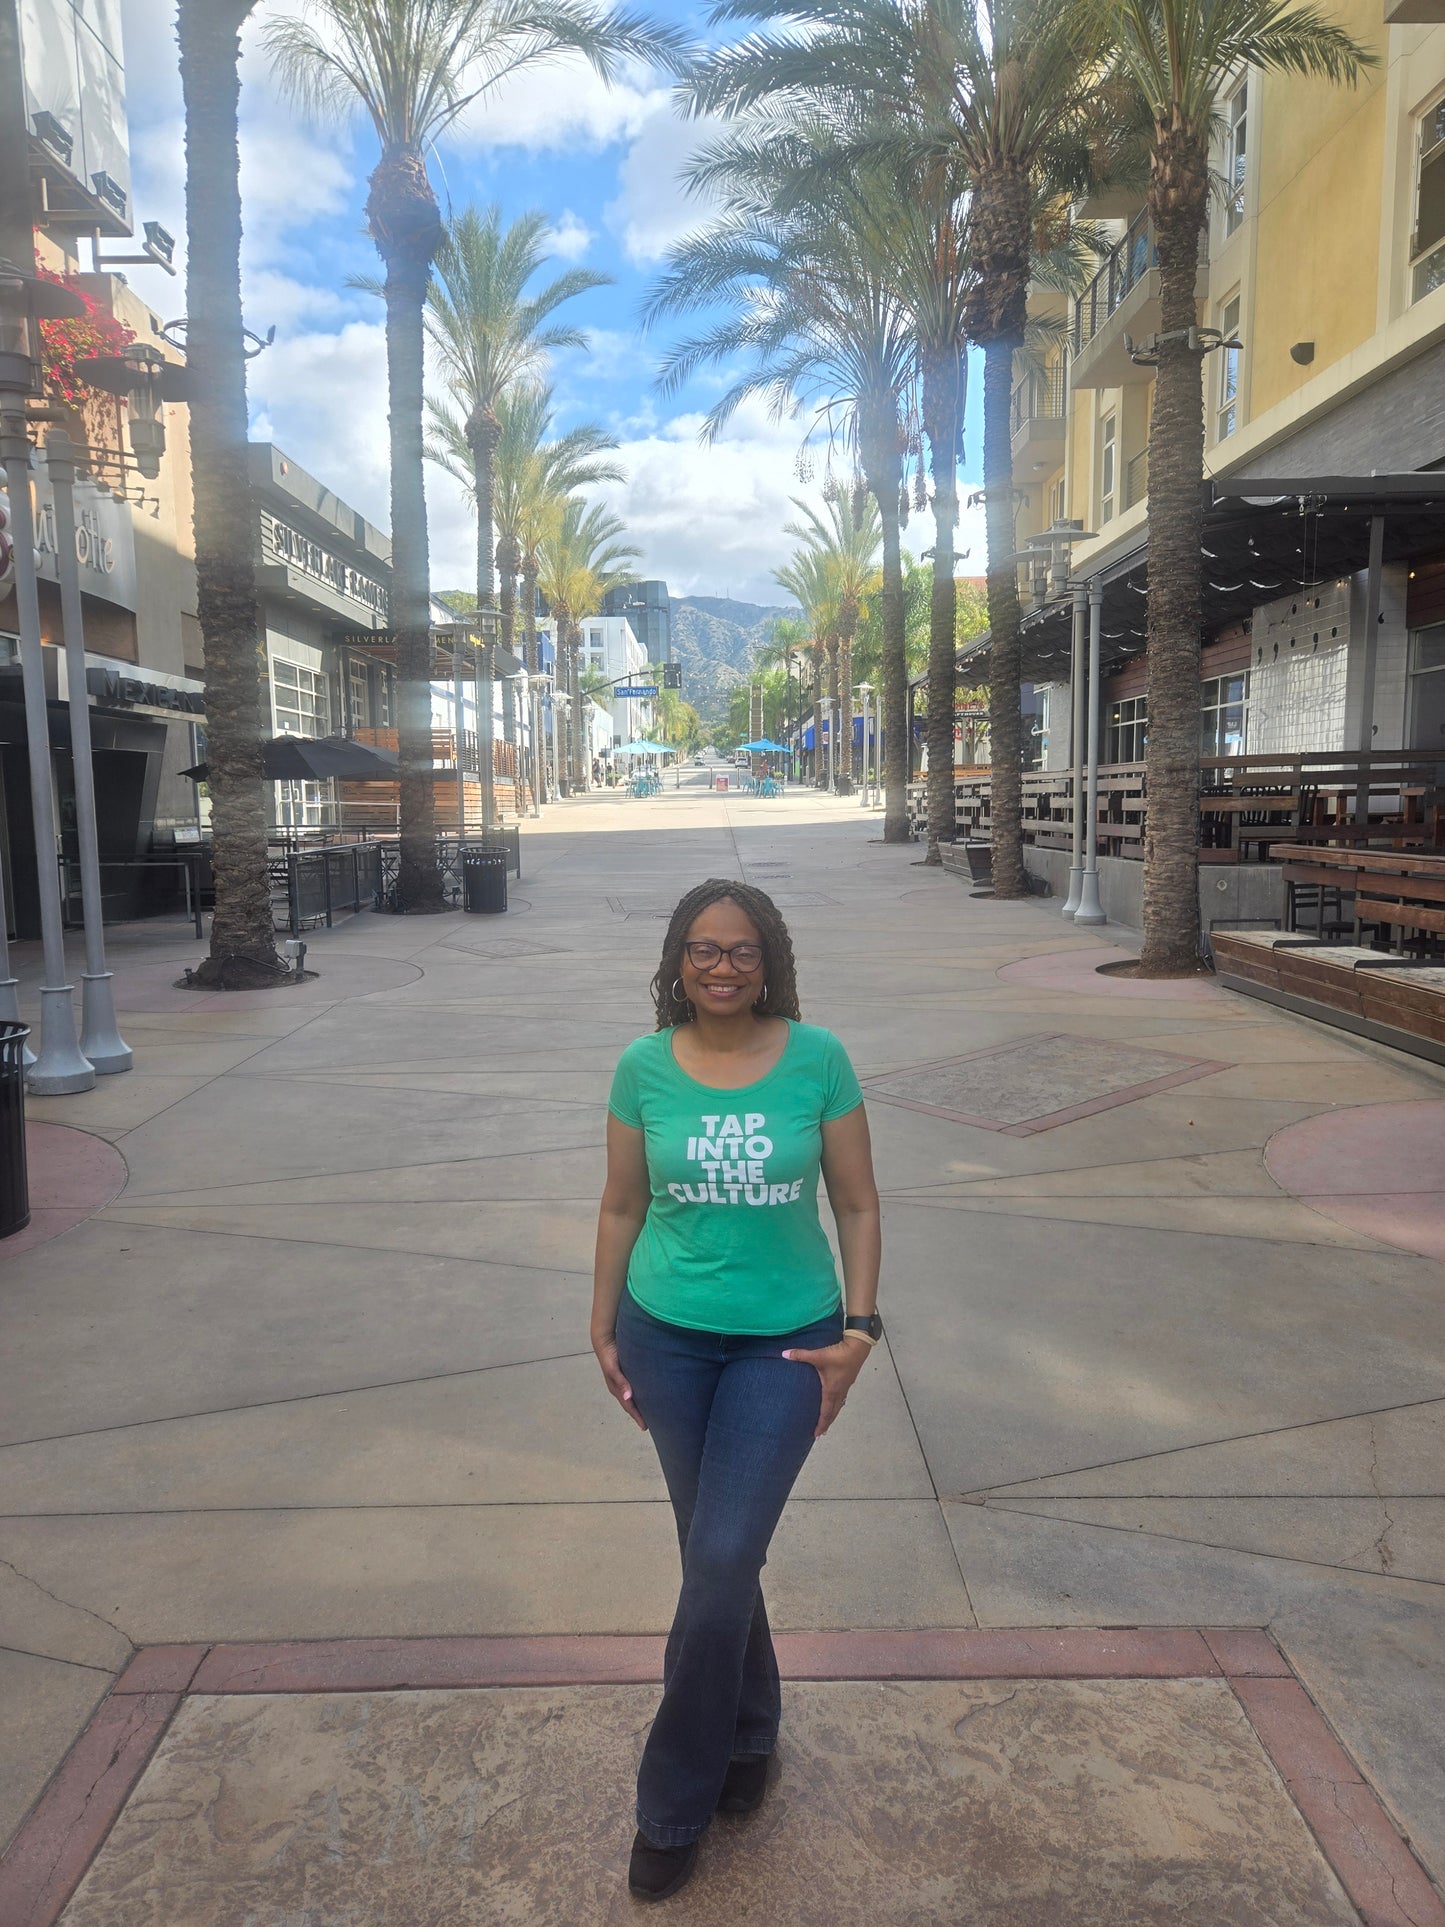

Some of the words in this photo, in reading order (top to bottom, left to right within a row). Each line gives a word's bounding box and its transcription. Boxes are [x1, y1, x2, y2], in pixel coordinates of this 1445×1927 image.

[29, 480, 115, 574] hiotle
[344, 635, 398, 643] SILVERLA
[701, 1113, 766, 1137] TAP
[687, 1135, 774, 1161] INTO
[701, 1160, 765, 1184] THE
[667, 1178, 804, 1206] CULTURE
